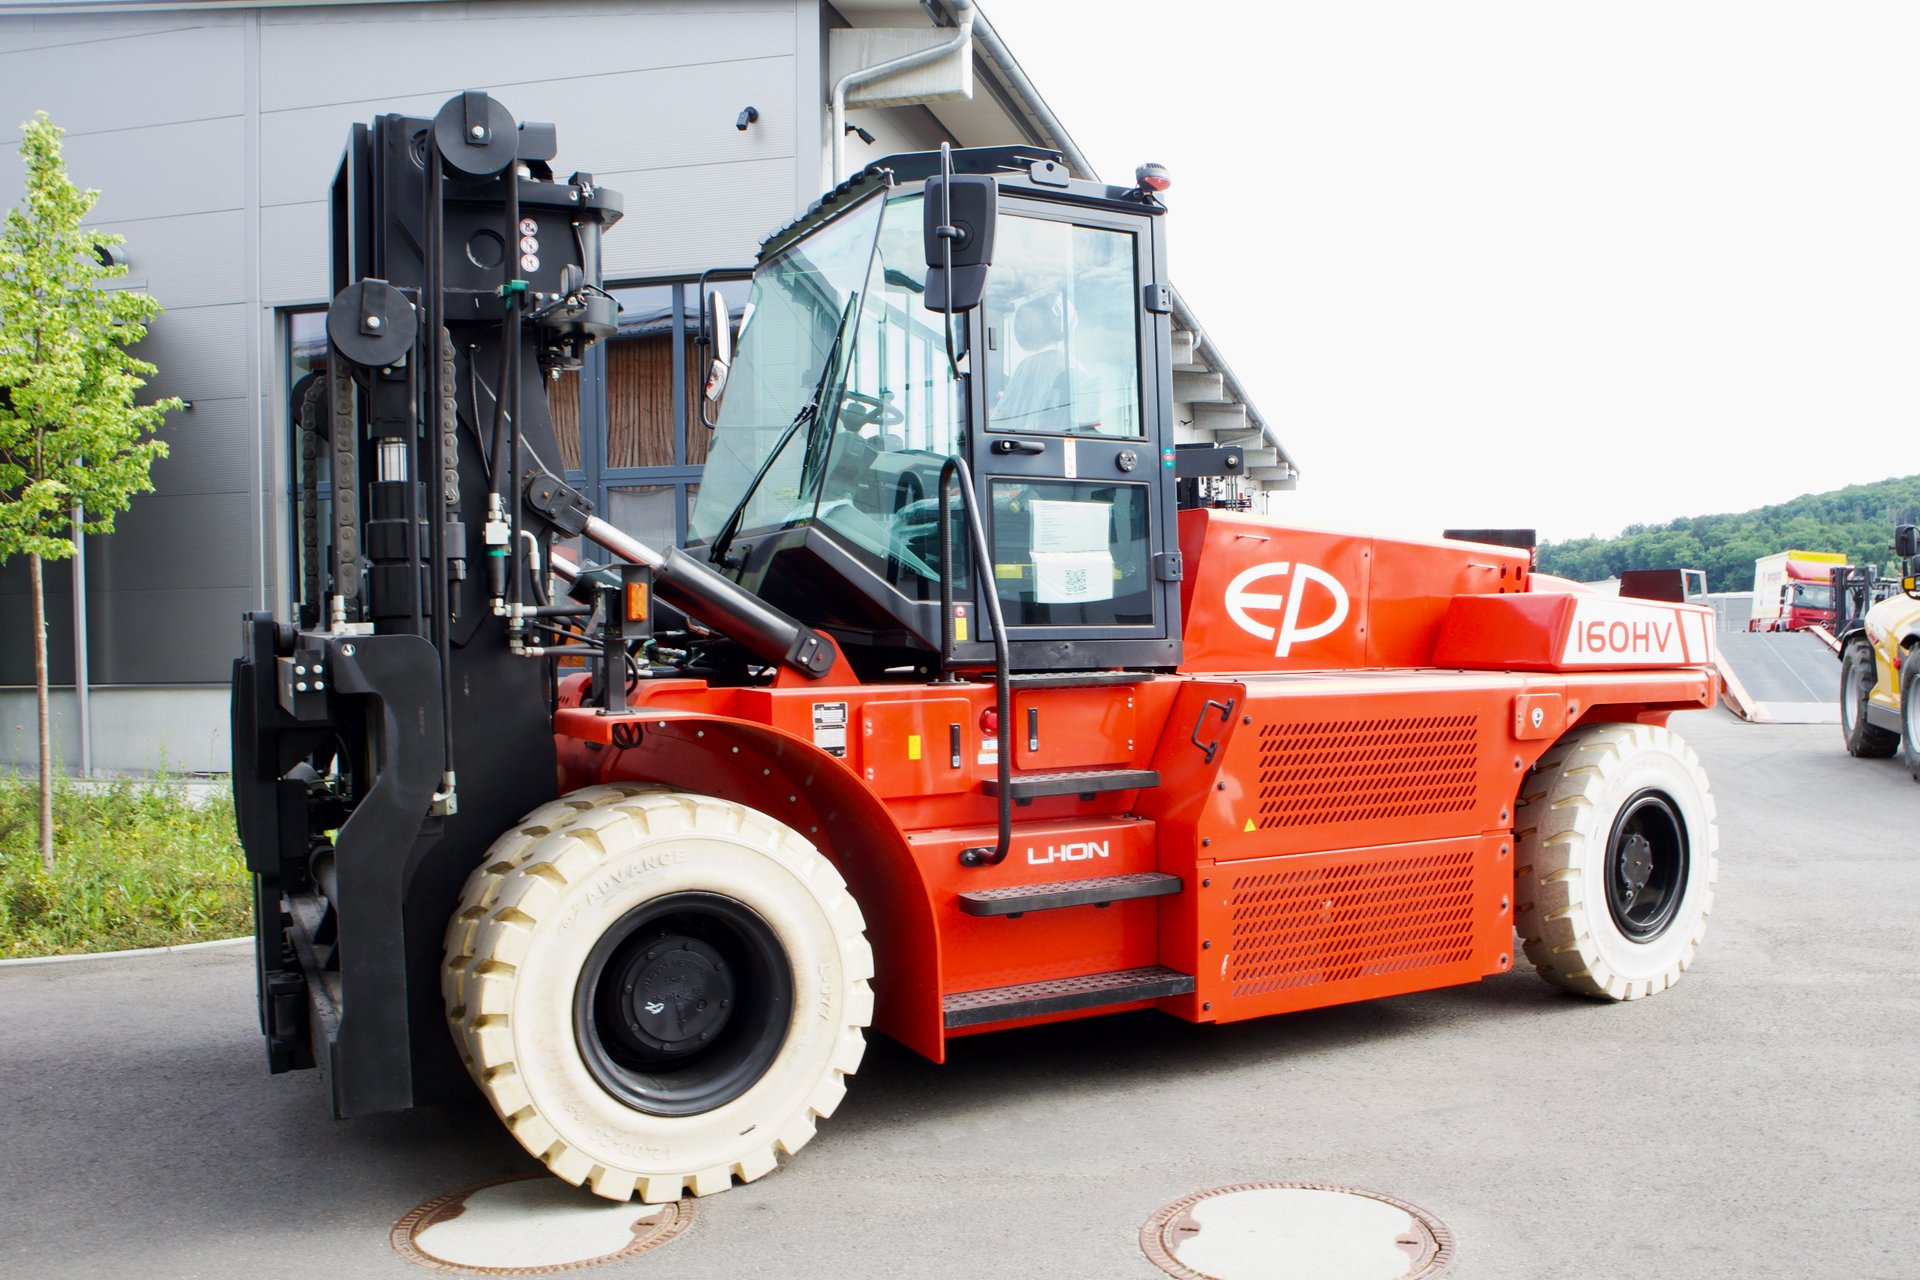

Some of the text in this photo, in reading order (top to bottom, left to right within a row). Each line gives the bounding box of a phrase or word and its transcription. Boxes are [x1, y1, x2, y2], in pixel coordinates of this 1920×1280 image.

[1224, 561, 1350, 658] EP
[1577, 620, 1673, 653] 160HV
[584, 848, 689, 907] ADVANCE
